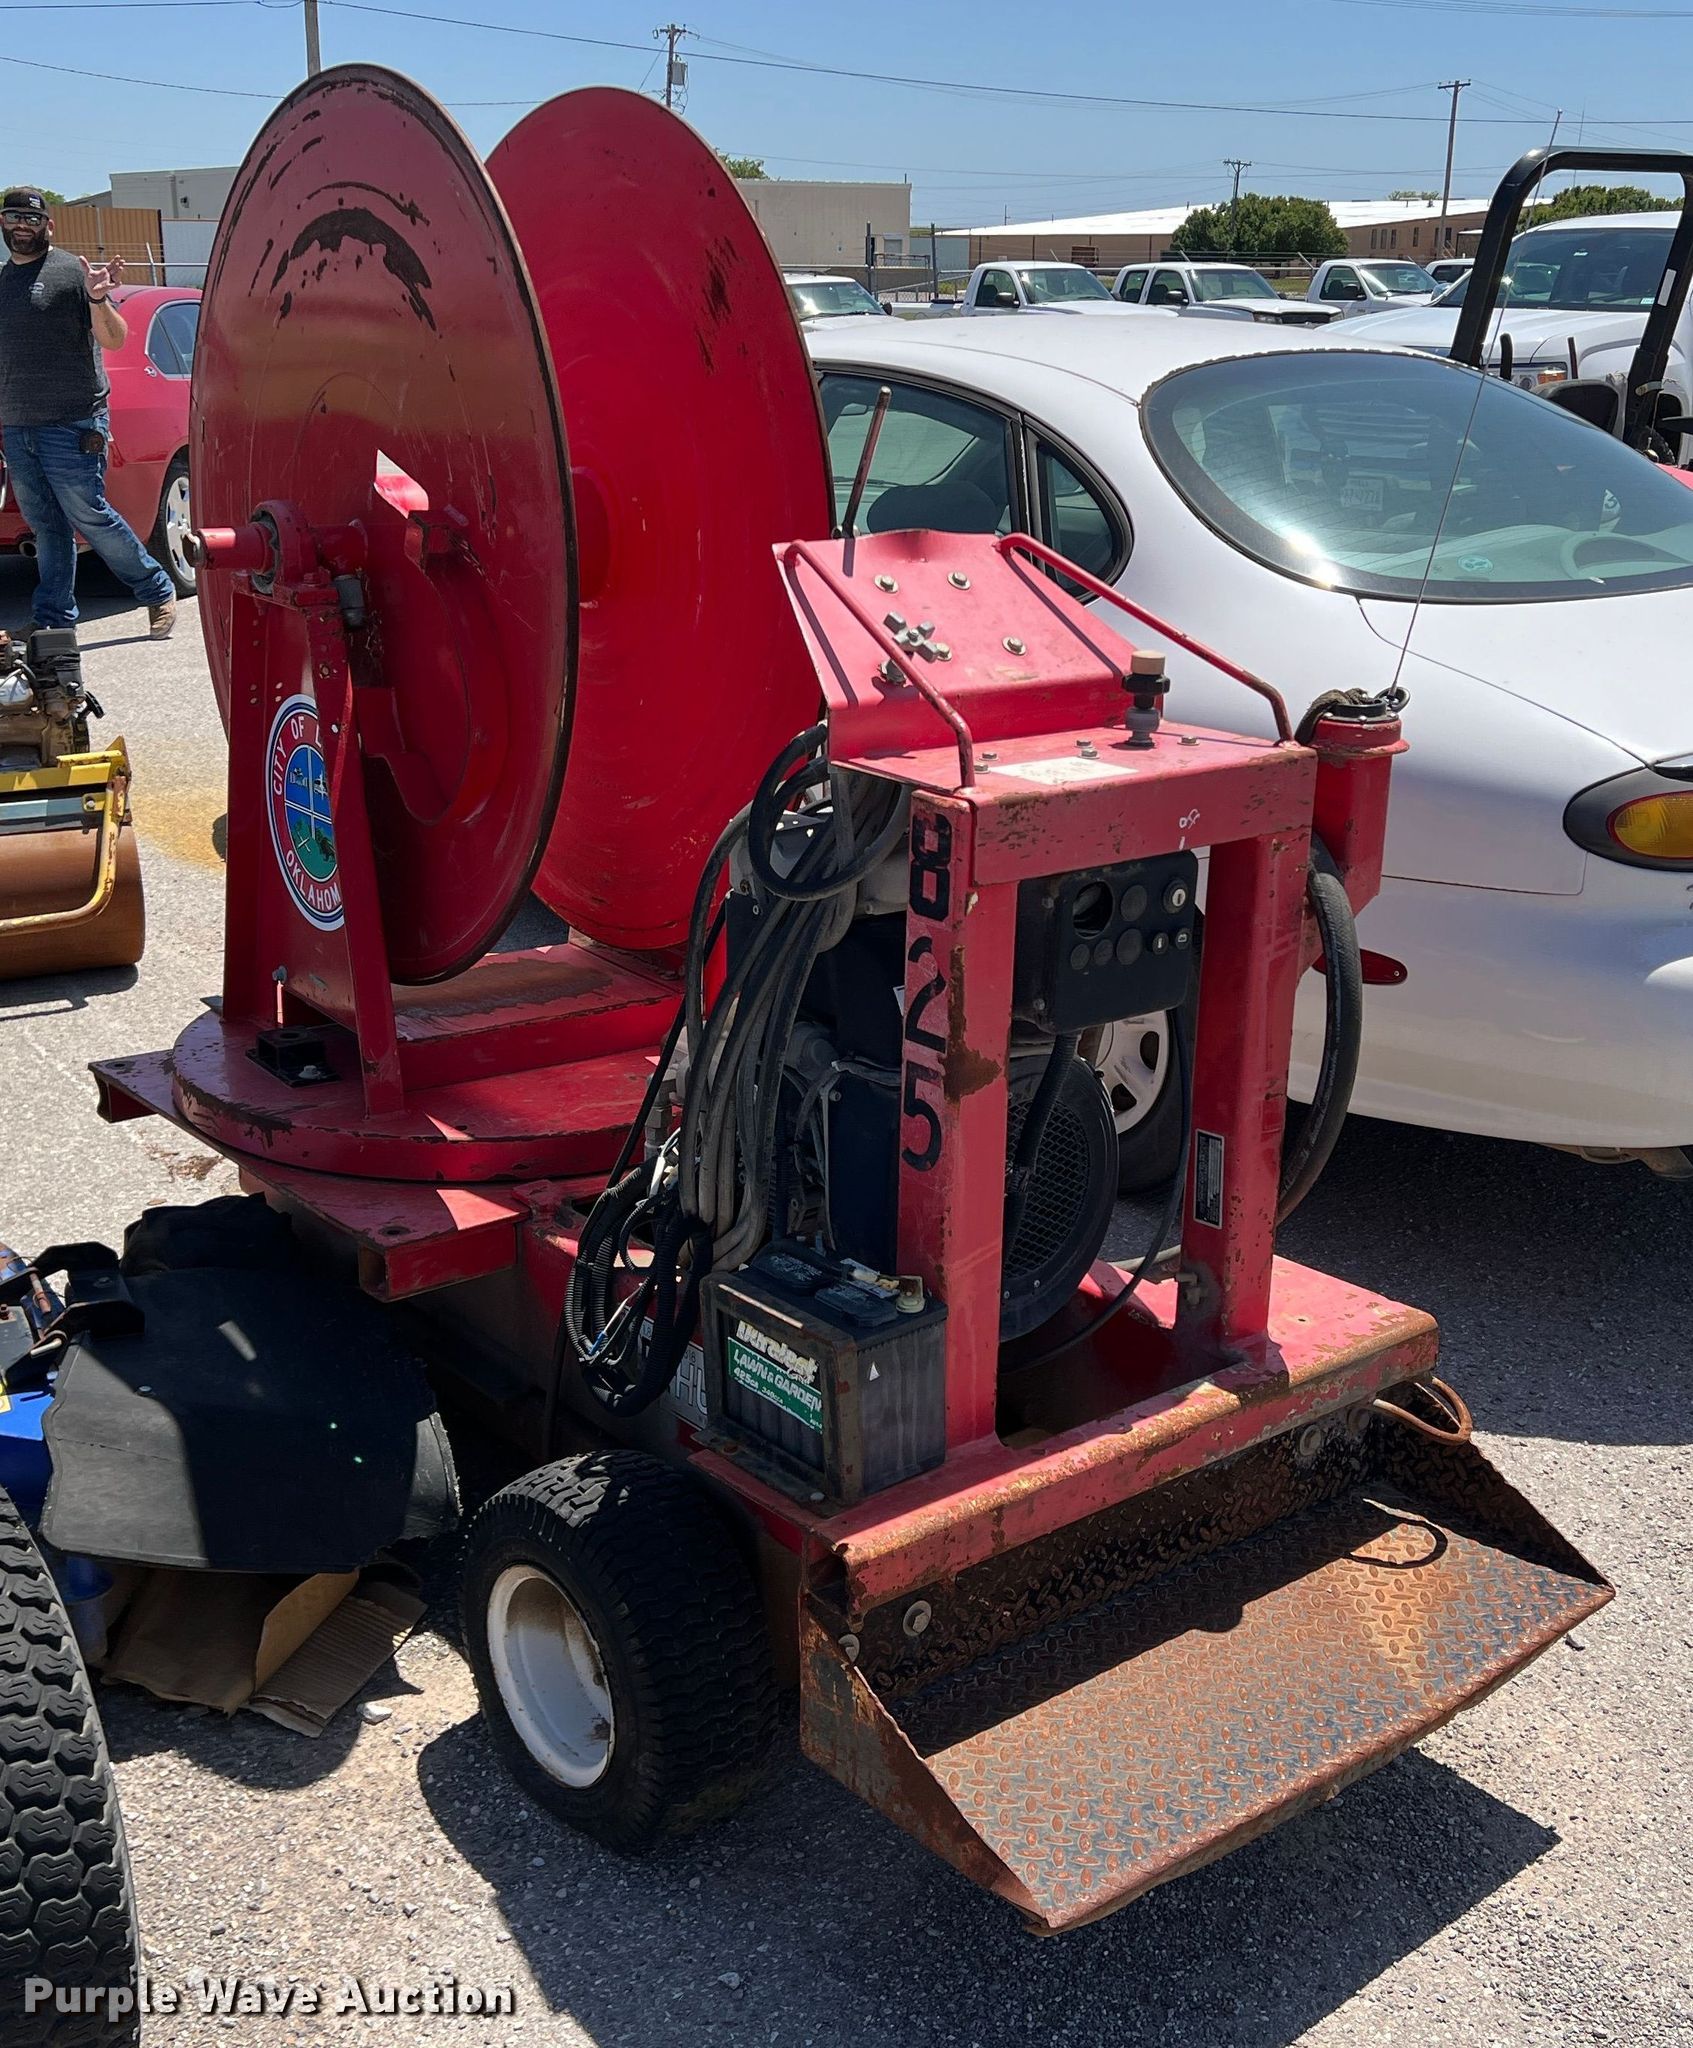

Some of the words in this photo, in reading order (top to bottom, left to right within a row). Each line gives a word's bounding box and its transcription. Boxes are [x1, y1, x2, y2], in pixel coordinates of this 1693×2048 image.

[273, 737, 287, 796] CITY
[290, 715, 305, 740] OF
[286, 849, 342, 911] OKLAHOM
[733, 1348, 769, 1381] LAWN
[766, 1371, 775, 1384] &
[773, 1373, 823, 1413] GARDEN
